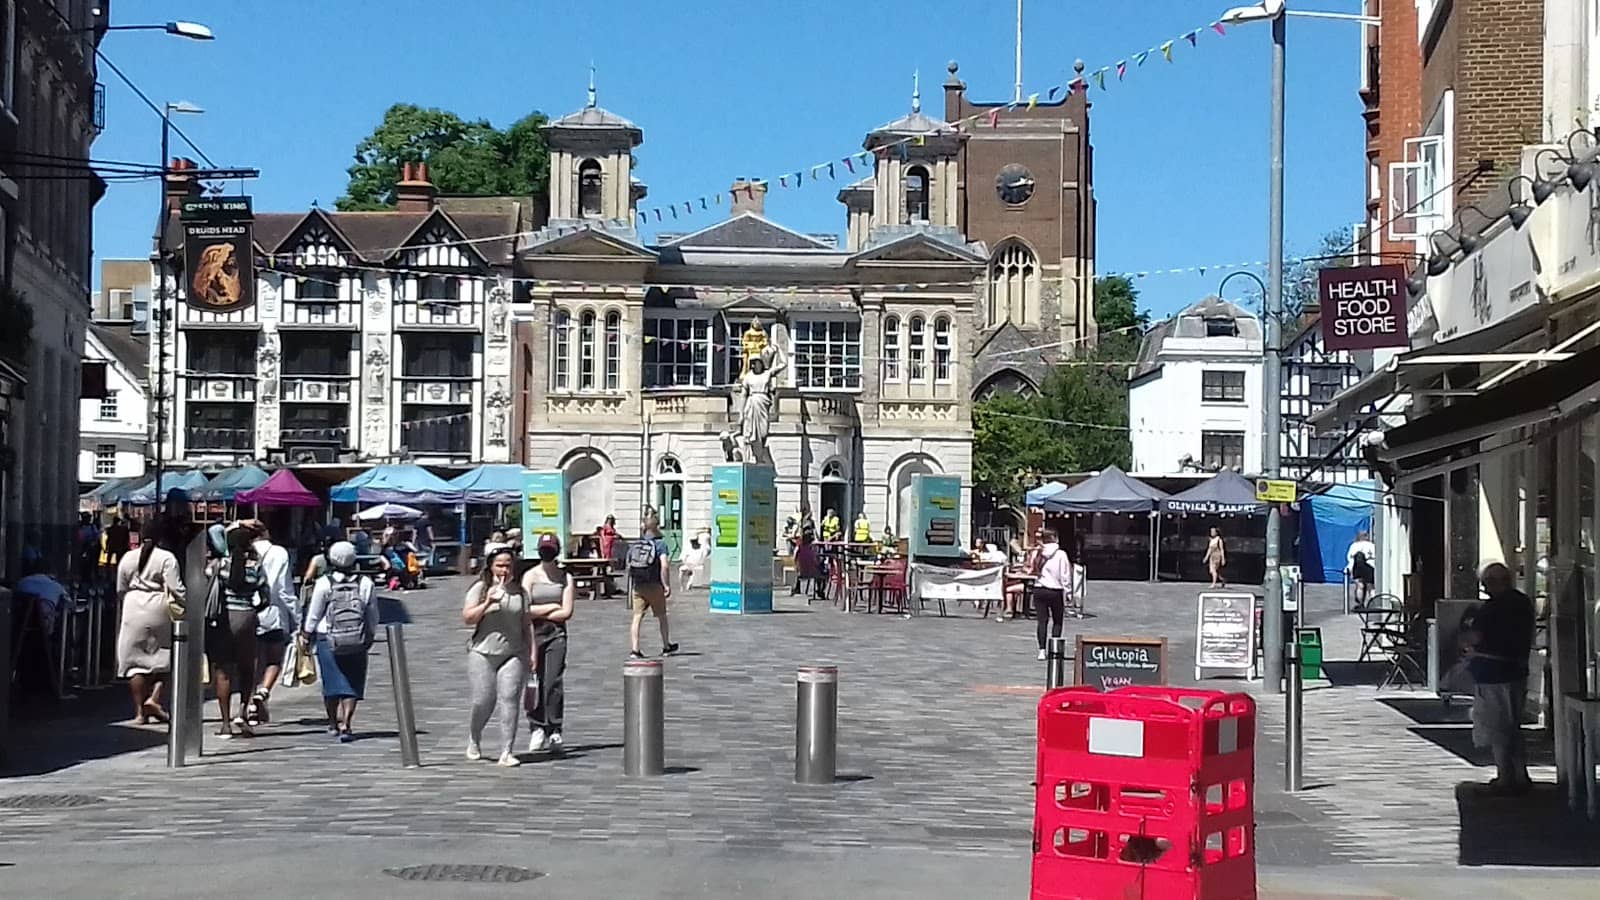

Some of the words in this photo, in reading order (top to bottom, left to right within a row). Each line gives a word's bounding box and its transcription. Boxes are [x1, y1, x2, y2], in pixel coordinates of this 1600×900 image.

[223, 202, 247, 210] KING
[221, 226, 246, 234] HEAD
[1328, 278, 1397, 299] HEALTH
[1337, 298, 1391, 317] FOOD
[1334, 315, 1397, 336] STORE
[1091, 646, 1149, 665] Glutopia
